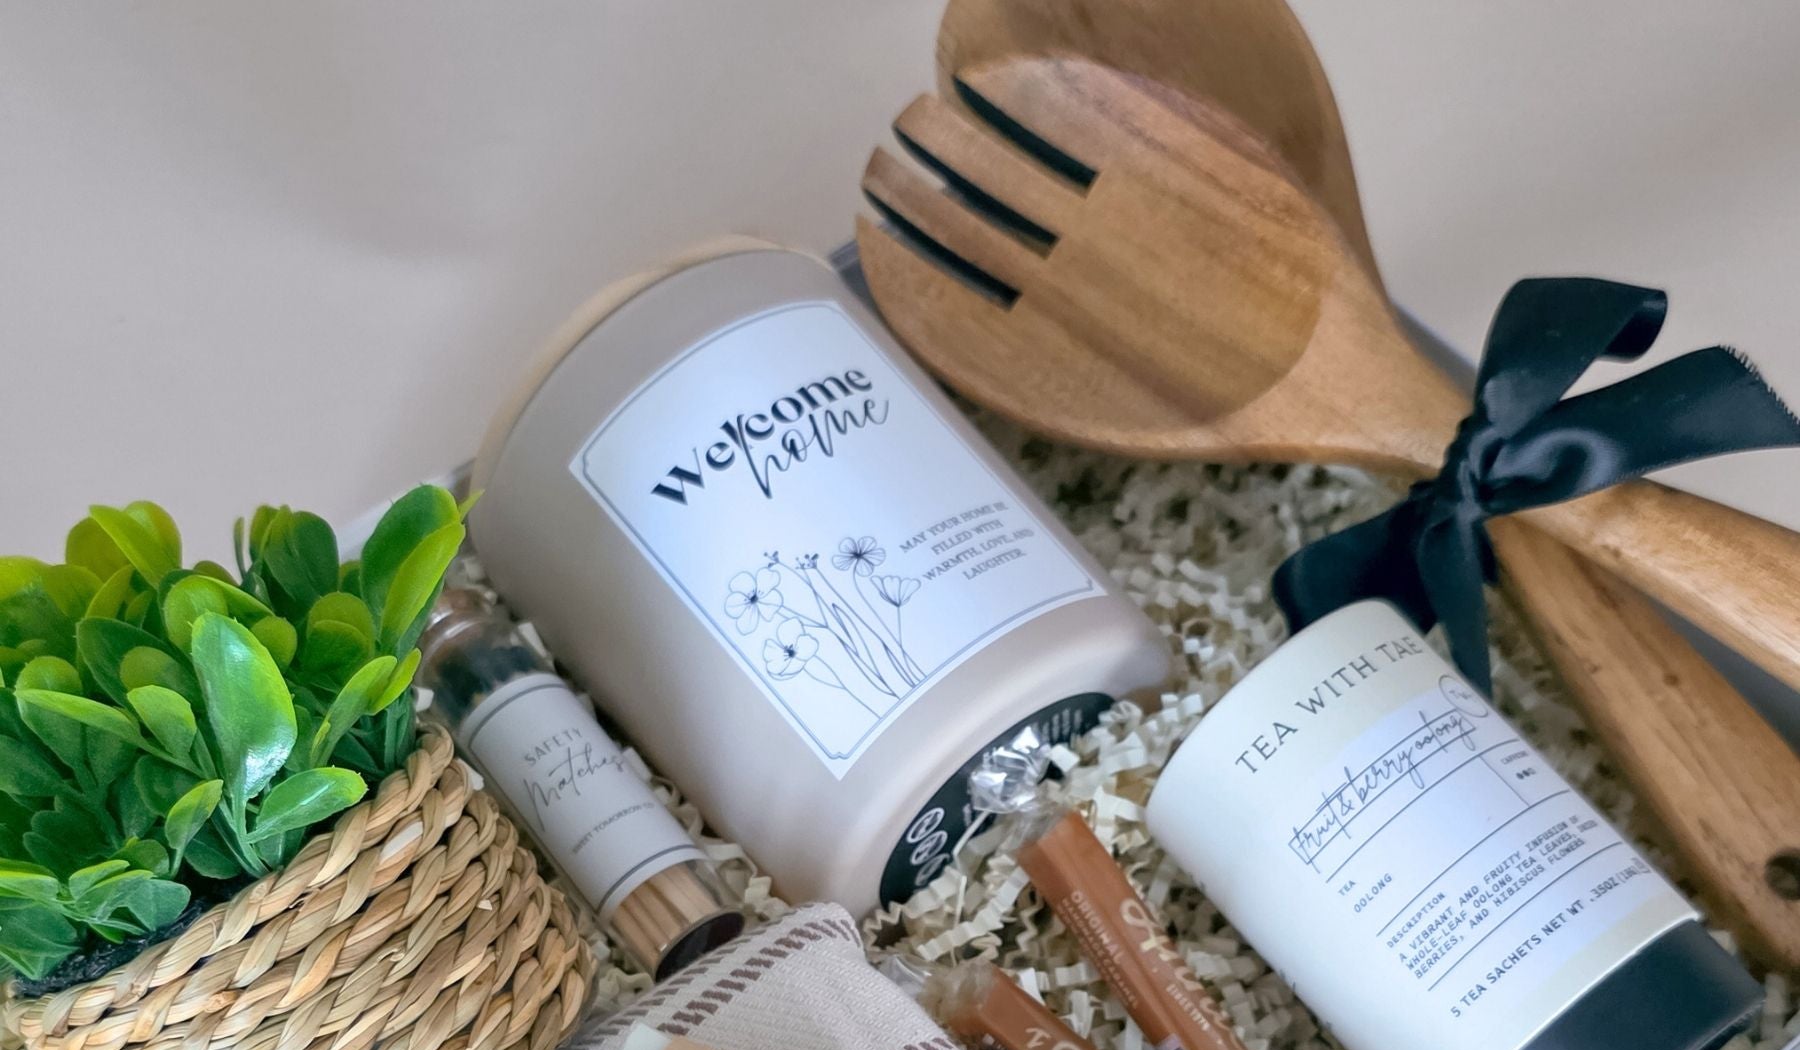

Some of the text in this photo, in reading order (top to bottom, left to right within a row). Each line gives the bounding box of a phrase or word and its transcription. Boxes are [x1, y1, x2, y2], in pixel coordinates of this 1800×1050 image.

[736, 399, 890, 499] home
[899, 532, 928, 553] MAY
[927, 516, 962, 536] YOUR
[960, 505, 996, 522] HOME
[931, 519, 1004, 555] FILLED WITH
[1235, 636, 1423, 774] TEA WITH TAE
[524, 727, 583, 767] SAFETY
[1338, 880, 1356, 896] TEA
[1354, 873, 1392, 913] OOLONG
[1387, 892, 1445, 948] DESCRIPTION
[1399, 953, 1407, 963] A
[1409, 906, 1454, 950] VIBRANT
[1459, 885, 1479, 907] AND
[1483, 851, 1521, 885] FRUITY
[1525, 821, 1568, 852] INFUSION
[1406, 910, 1467, 970] WHOLE-LEAF
[1473, 874, 1512, 909] OOLONG
[1516, 856, 1537, 873] TEA
[1540, 832, 1578, 856] LEAVES,
[1413, 838, 1585, 979] BERRIES, AND HIBISCUS FLOWERS
[1069, 889, 1125, 965] ORIGINAL
[1450, 1006, 1461, 1018] 5
[1460, 984, 1487, 1007] TEA
[1486, 934, 1542, 984] SACHETS
[1541, 912, 1567, 936] NET
[1566, 899, 1584, 916] WT
